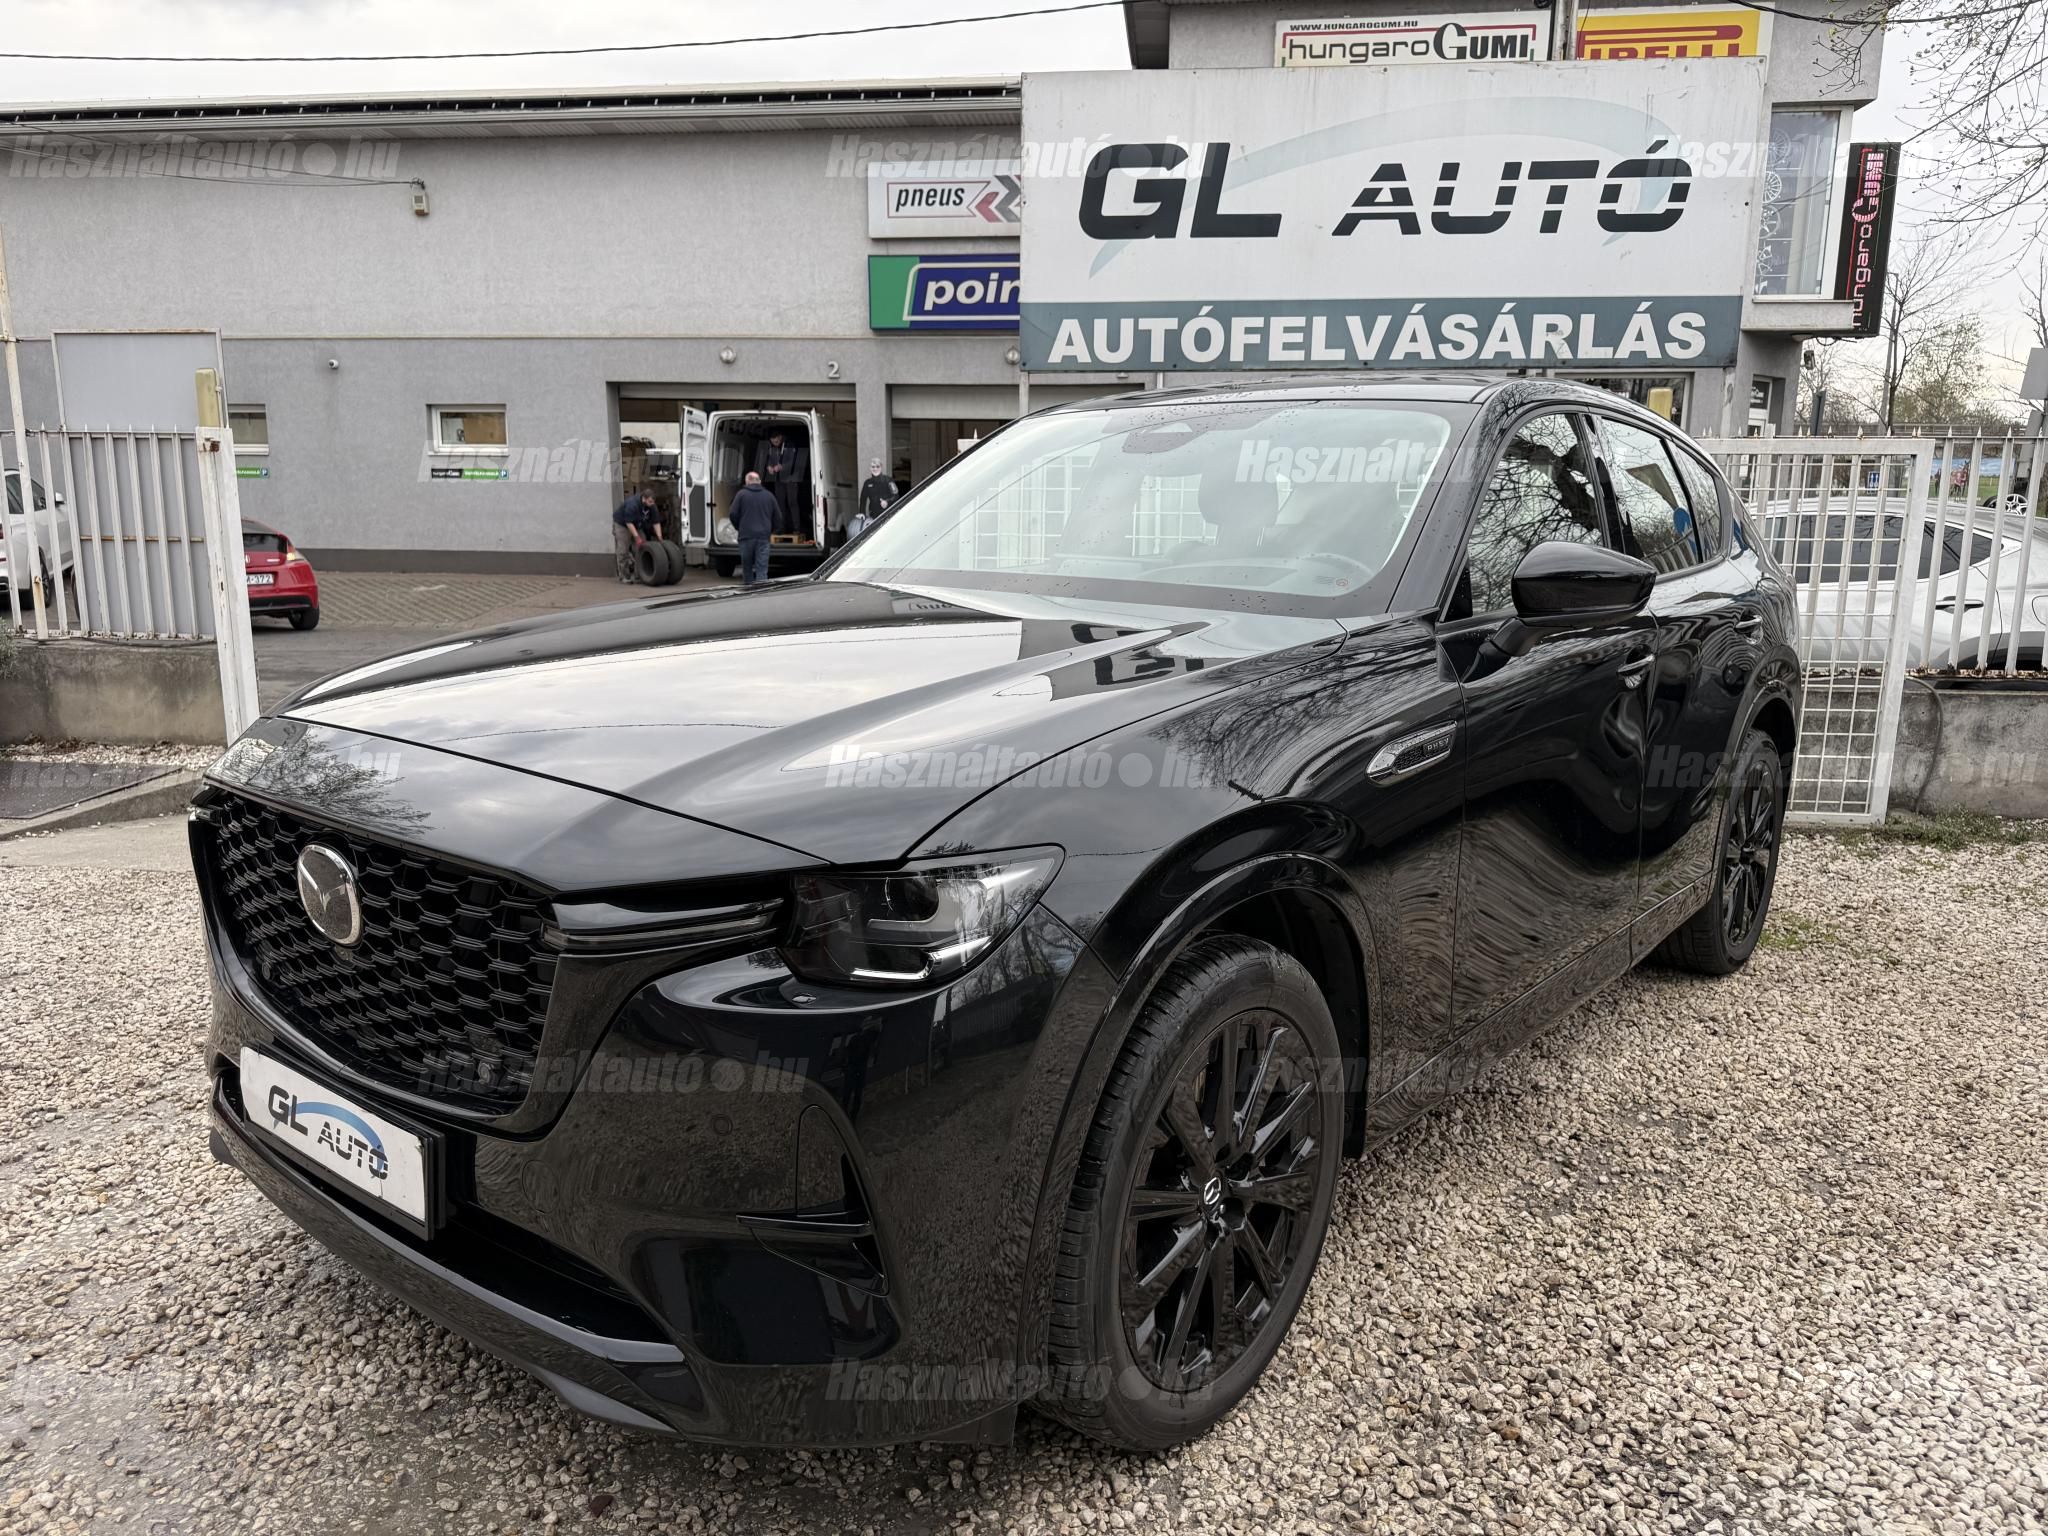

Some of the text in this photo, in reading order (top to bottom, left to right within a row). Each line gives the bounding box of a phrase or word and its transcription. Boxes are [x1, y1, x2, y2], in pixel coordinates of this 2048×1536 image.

[1290, 20, 1418, 31] WWW.HUNGAROGUMI.HU
[896, 187, 965, 212] pneus
[1079, 140, 1692, 239] GL AUTÓ
[1047, 302, 1706, 363] AUTÓFELVÁSÁRLÁS
[828, 361, 840, 378] 2
[268, 1085, 389, 1180] GL AUTÓ
